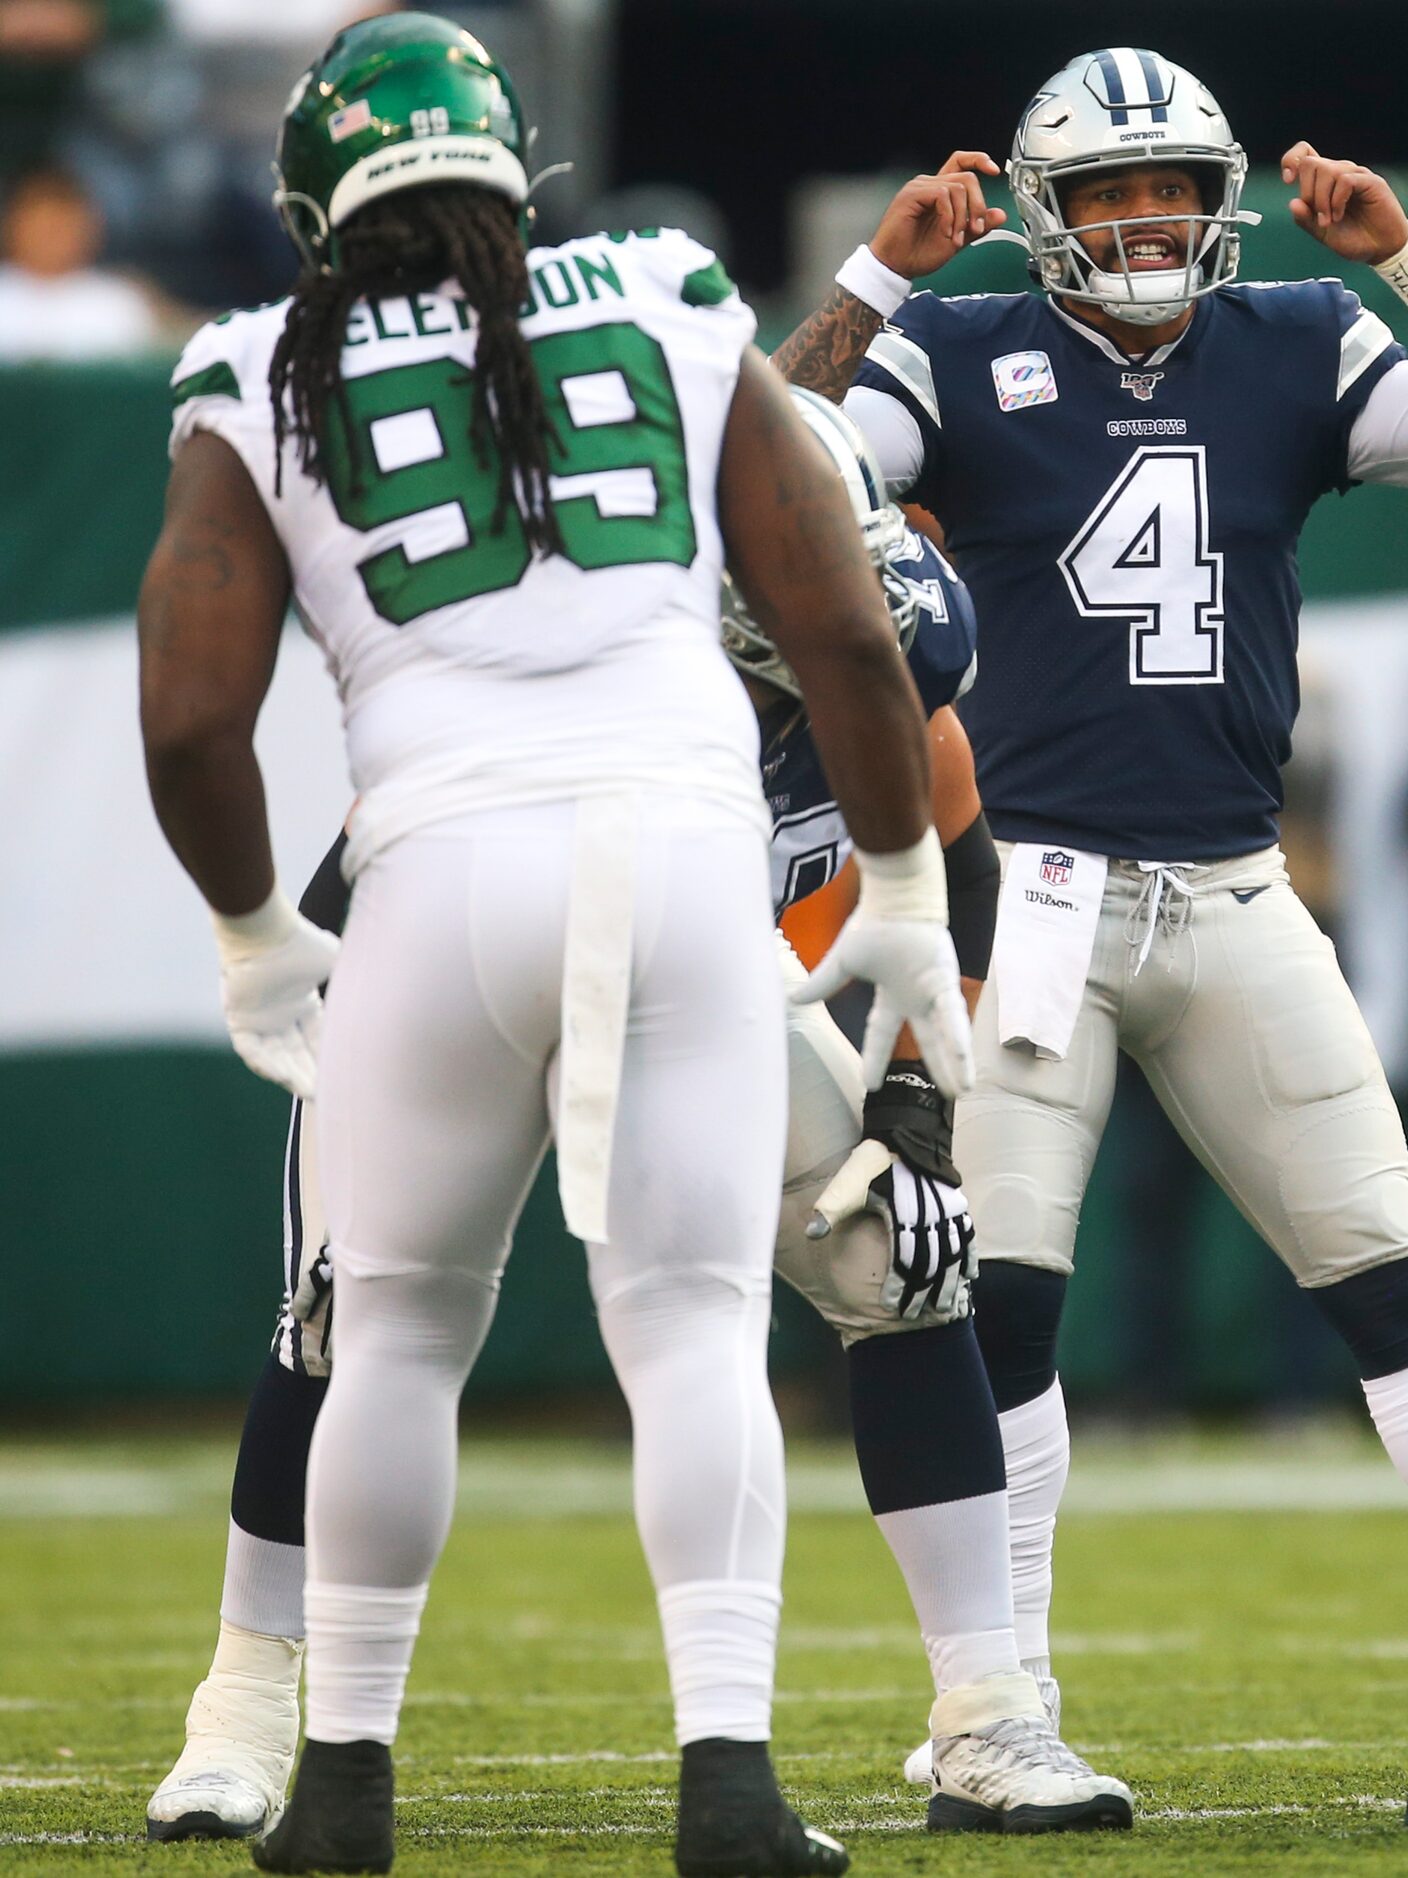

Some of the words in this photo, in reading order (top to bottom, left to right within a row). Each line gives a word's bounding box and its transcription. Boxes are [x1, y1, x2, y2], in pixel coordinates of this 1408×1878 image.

[408, 106, 450, 138] 99
[998, 351, 1052, 394] C
[1106, 419, 1188, 437] COWBOYS
[325, 321, 698, 626] 99
[1057, 444, 1225, 686] 4
[1042, 864, 1069, 884] NFL
[1024, 889, 1076, 911] Wilson
